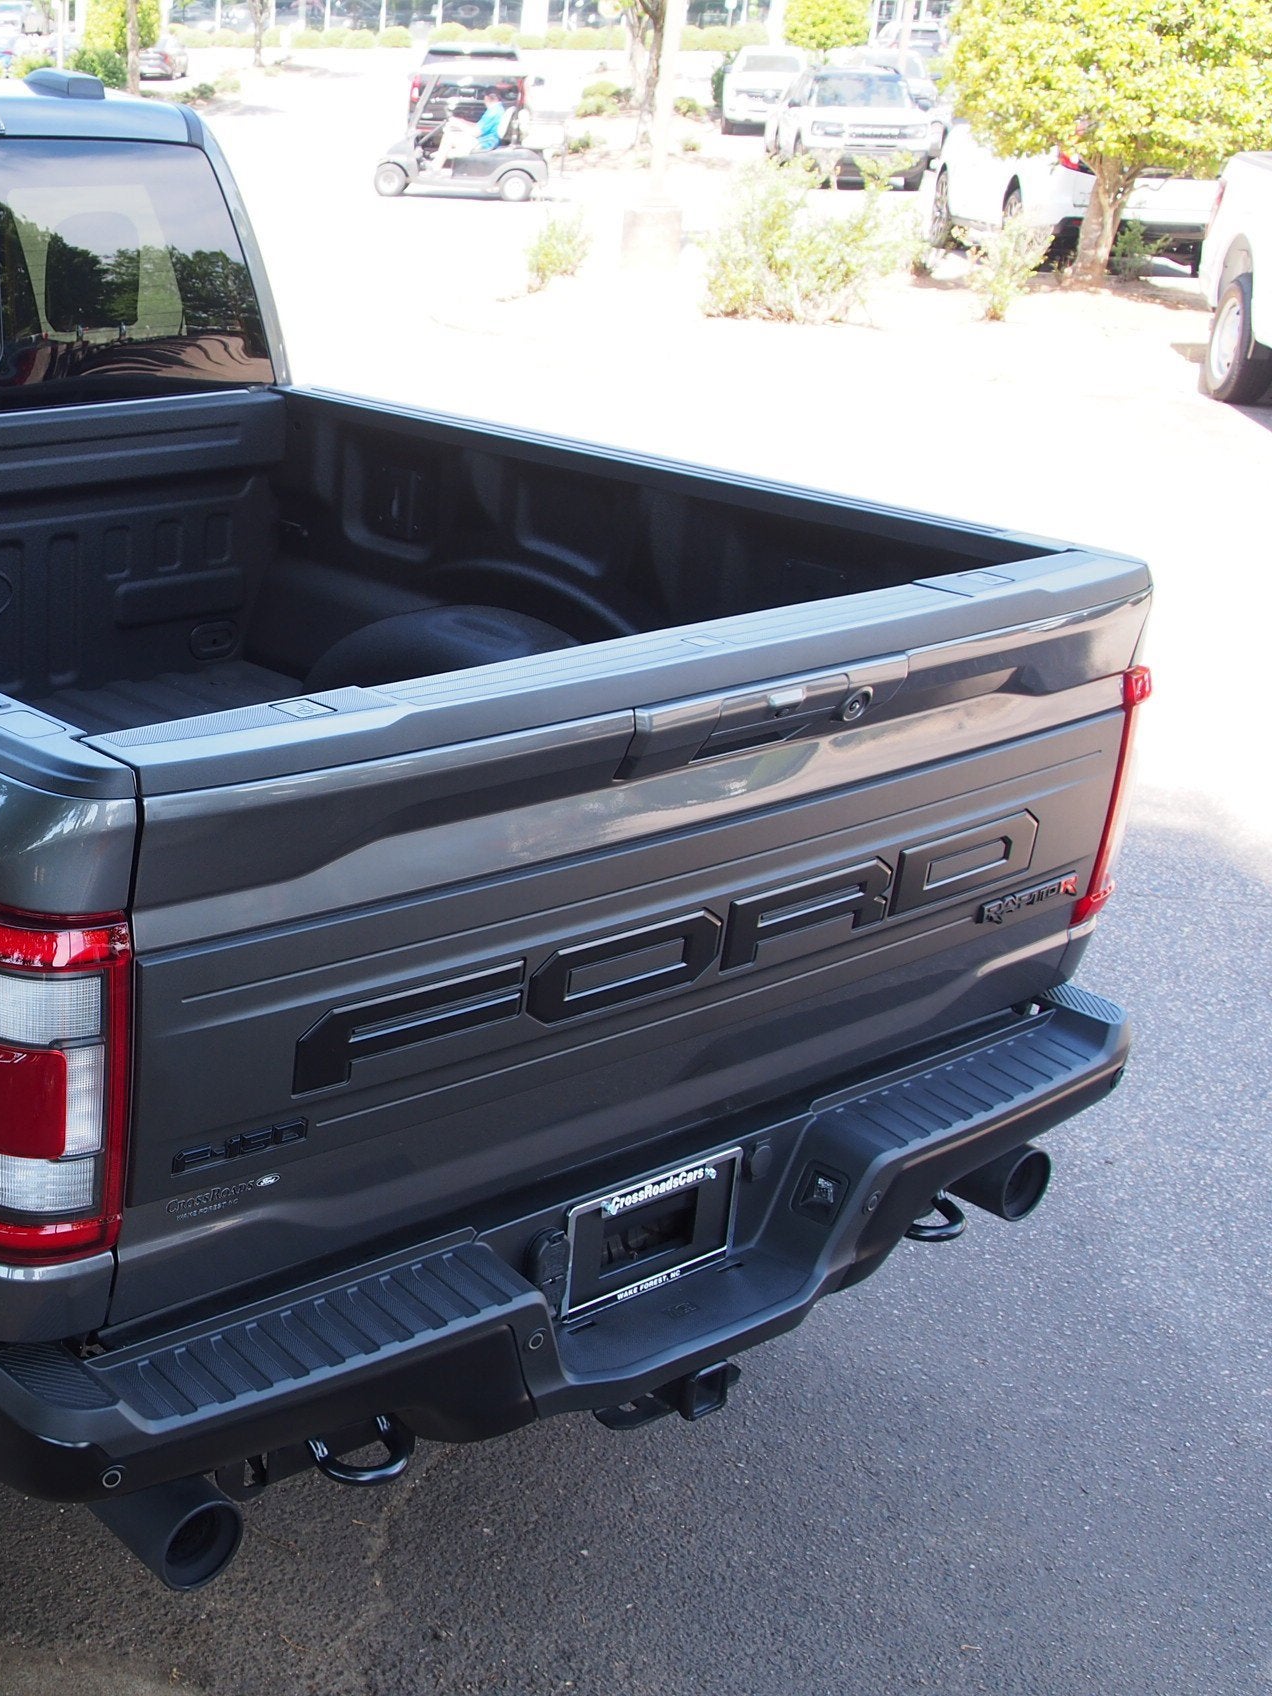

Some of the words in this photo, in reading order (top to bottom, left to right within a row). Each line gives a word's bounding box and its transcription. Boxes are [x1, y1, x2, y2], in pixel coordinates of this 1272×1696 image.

[975, 869, 1079, 924] RAPTOR
[290, 807, 1040, 1099] FORD
[172, 1116, 308, 1175] F-150
[612, 1168, 704, 1211] CrossRoadsCars
[616, 1286, 638, 1301] WAKE
[639, 1275, 669, 1291] FOREST,
[670, 1270, 681, 1279] NC
